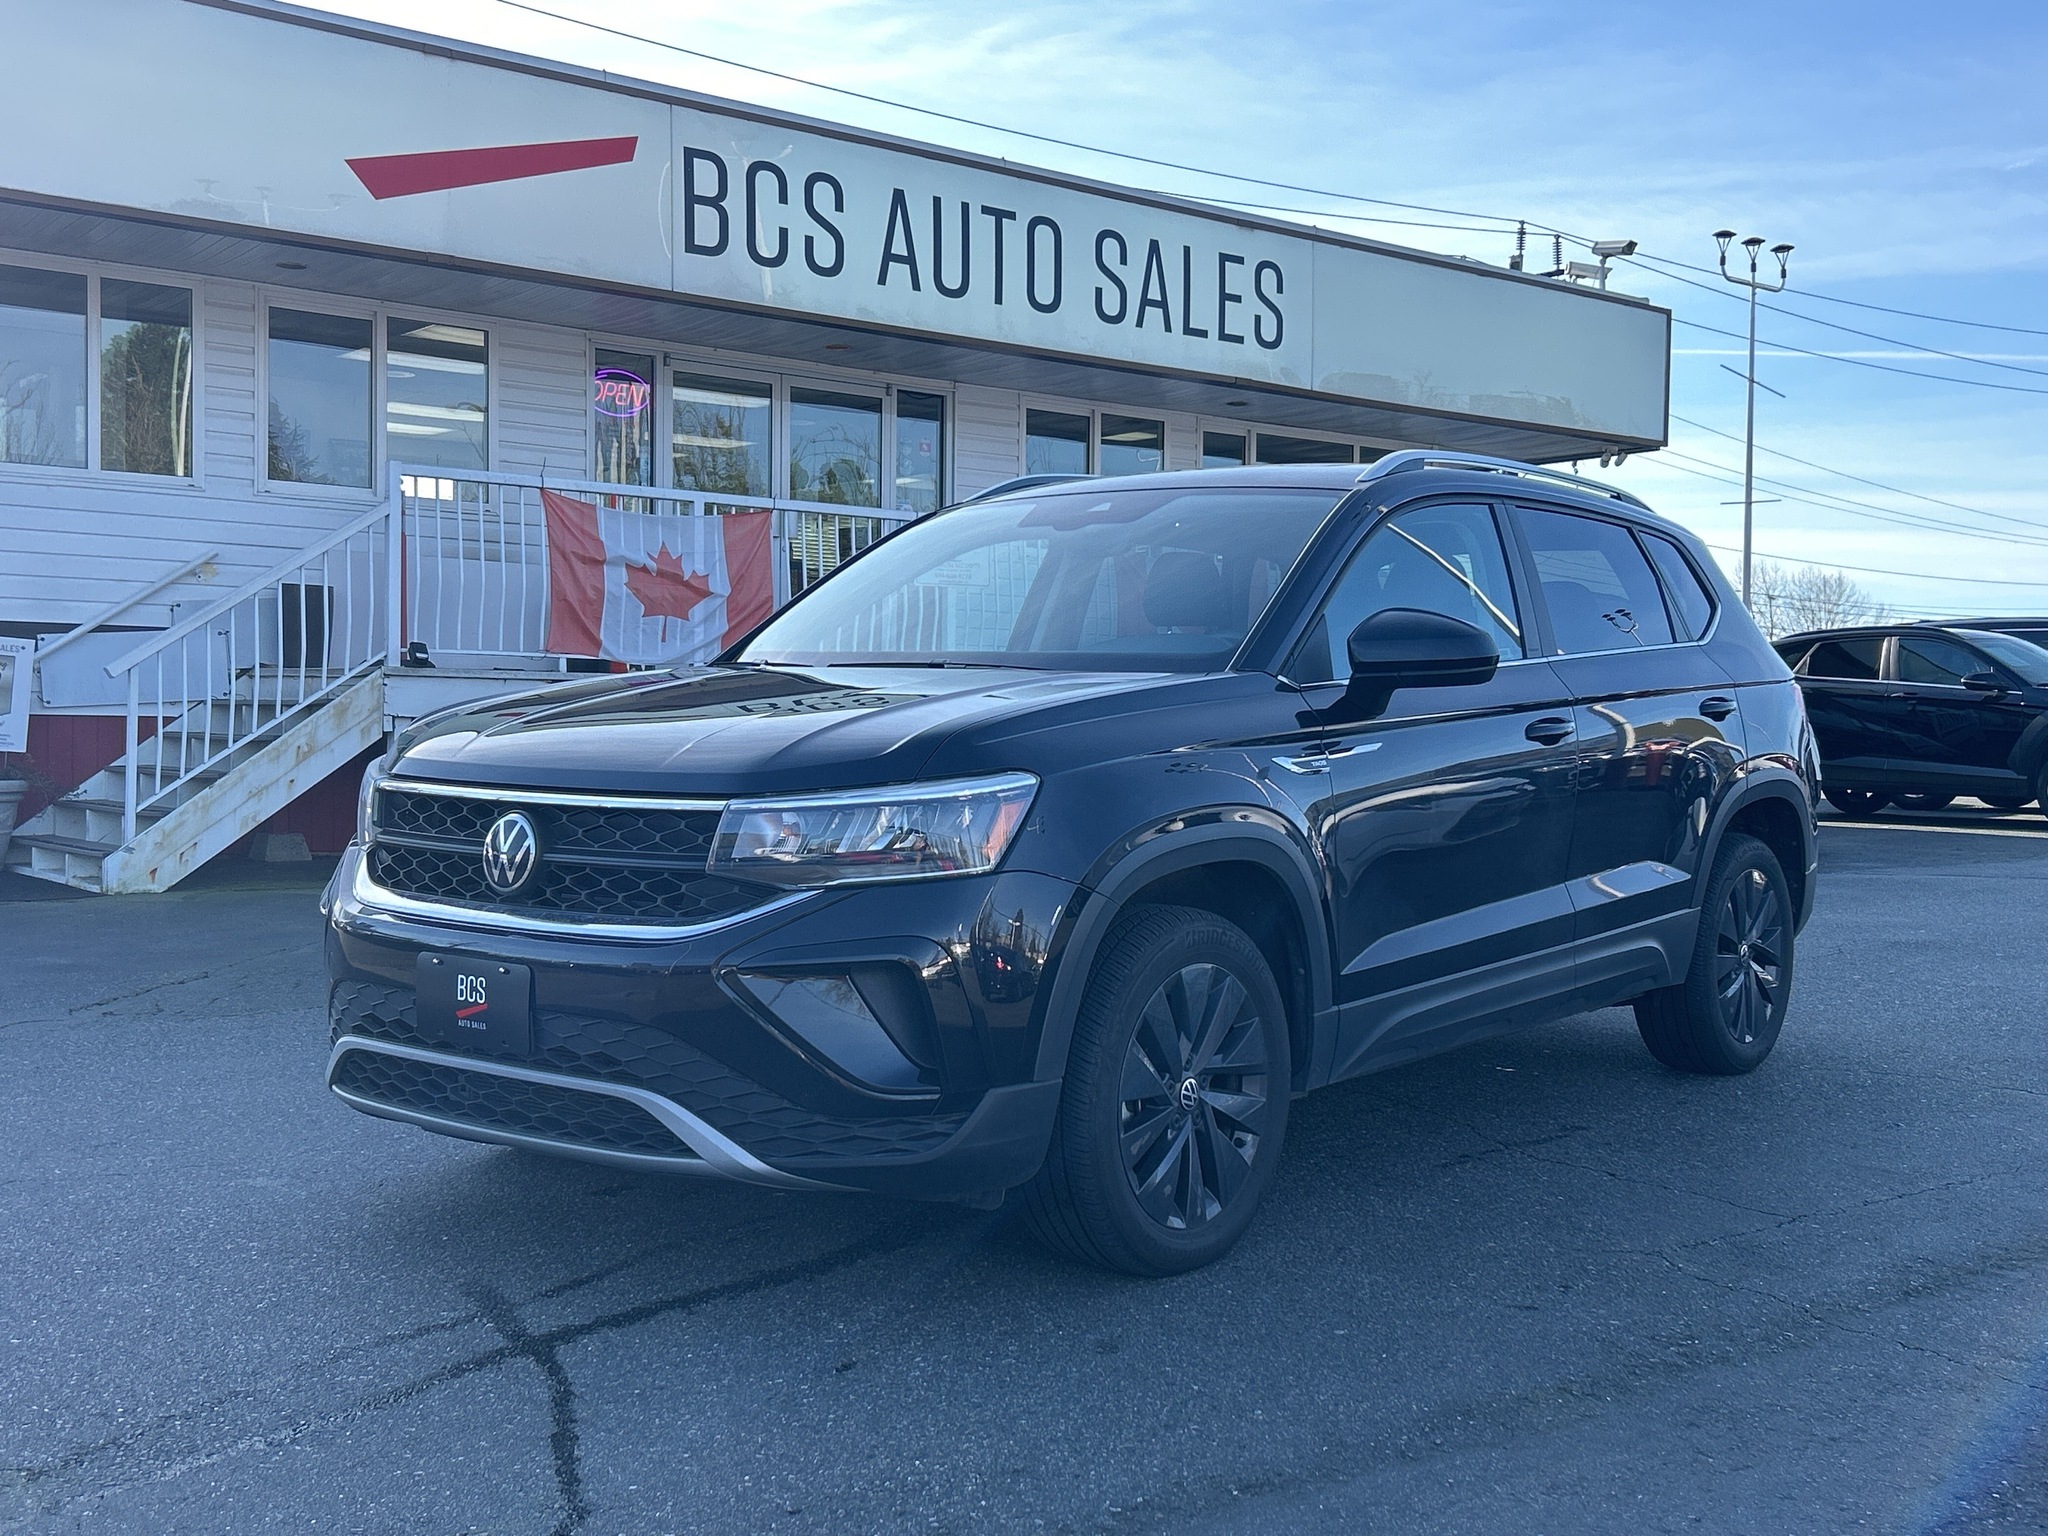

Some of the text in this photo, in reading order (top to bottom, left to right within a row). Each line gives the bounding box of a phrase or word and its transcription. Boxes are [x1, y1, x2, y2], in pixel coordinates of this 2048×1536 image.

[684, 146, 1283, 349] BCS AUTO SALES
[595, 380, 645, 407] OPEN
[0, 644, 20, 653] ALES
[457, 974, 486, 1003] BCS
[458, 1019, 486, 1030] AUTO SALES
